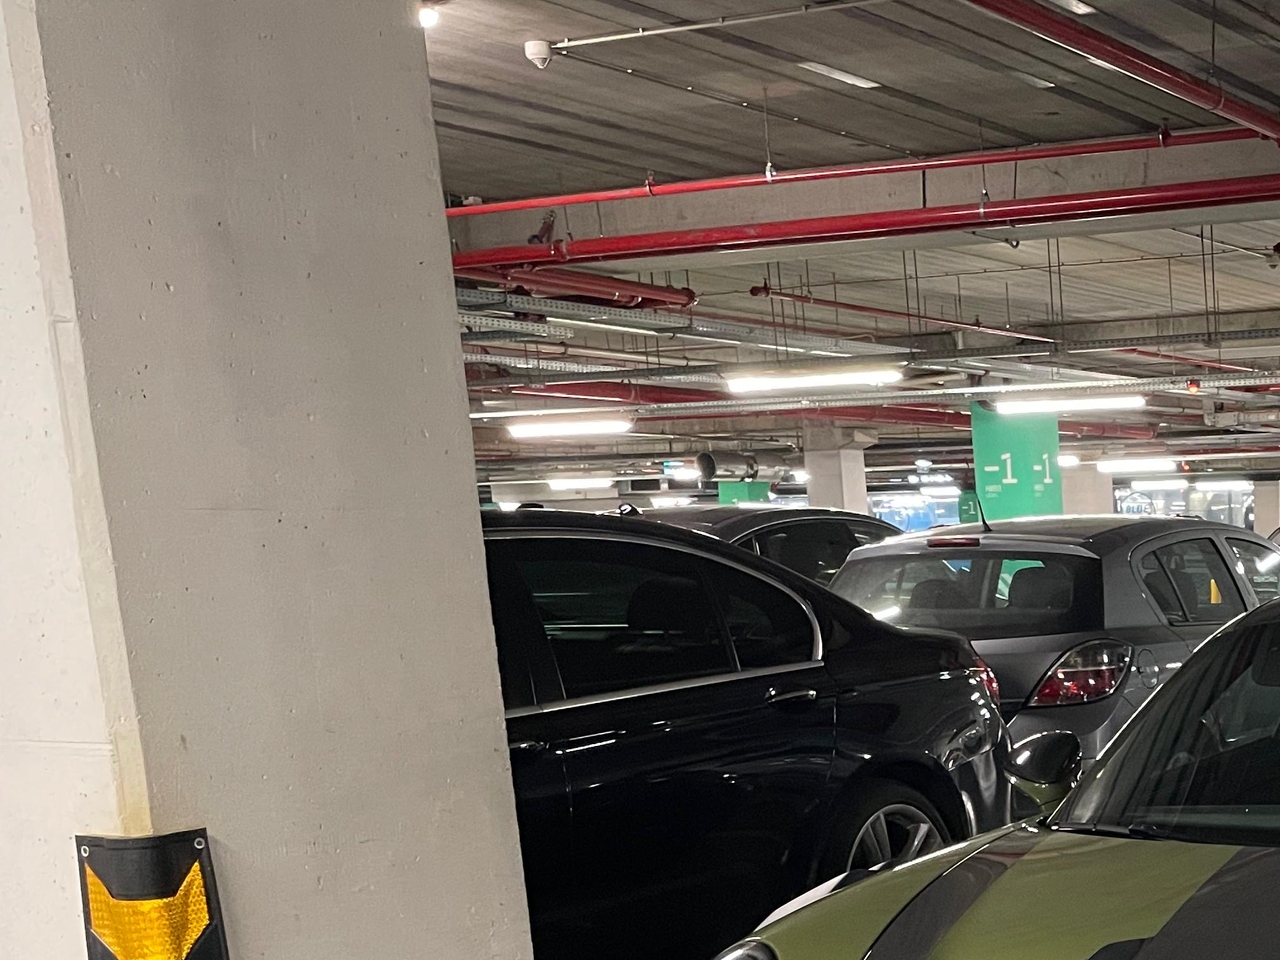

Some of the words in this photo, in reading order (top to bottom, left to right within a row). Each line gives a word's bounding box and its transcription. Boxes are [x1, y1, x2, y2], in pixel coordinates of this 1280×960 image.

[984, 453, 1018, 484] -1
[1033, 453, 1053, 484] -1
[962, 501, 976, 514] -1
